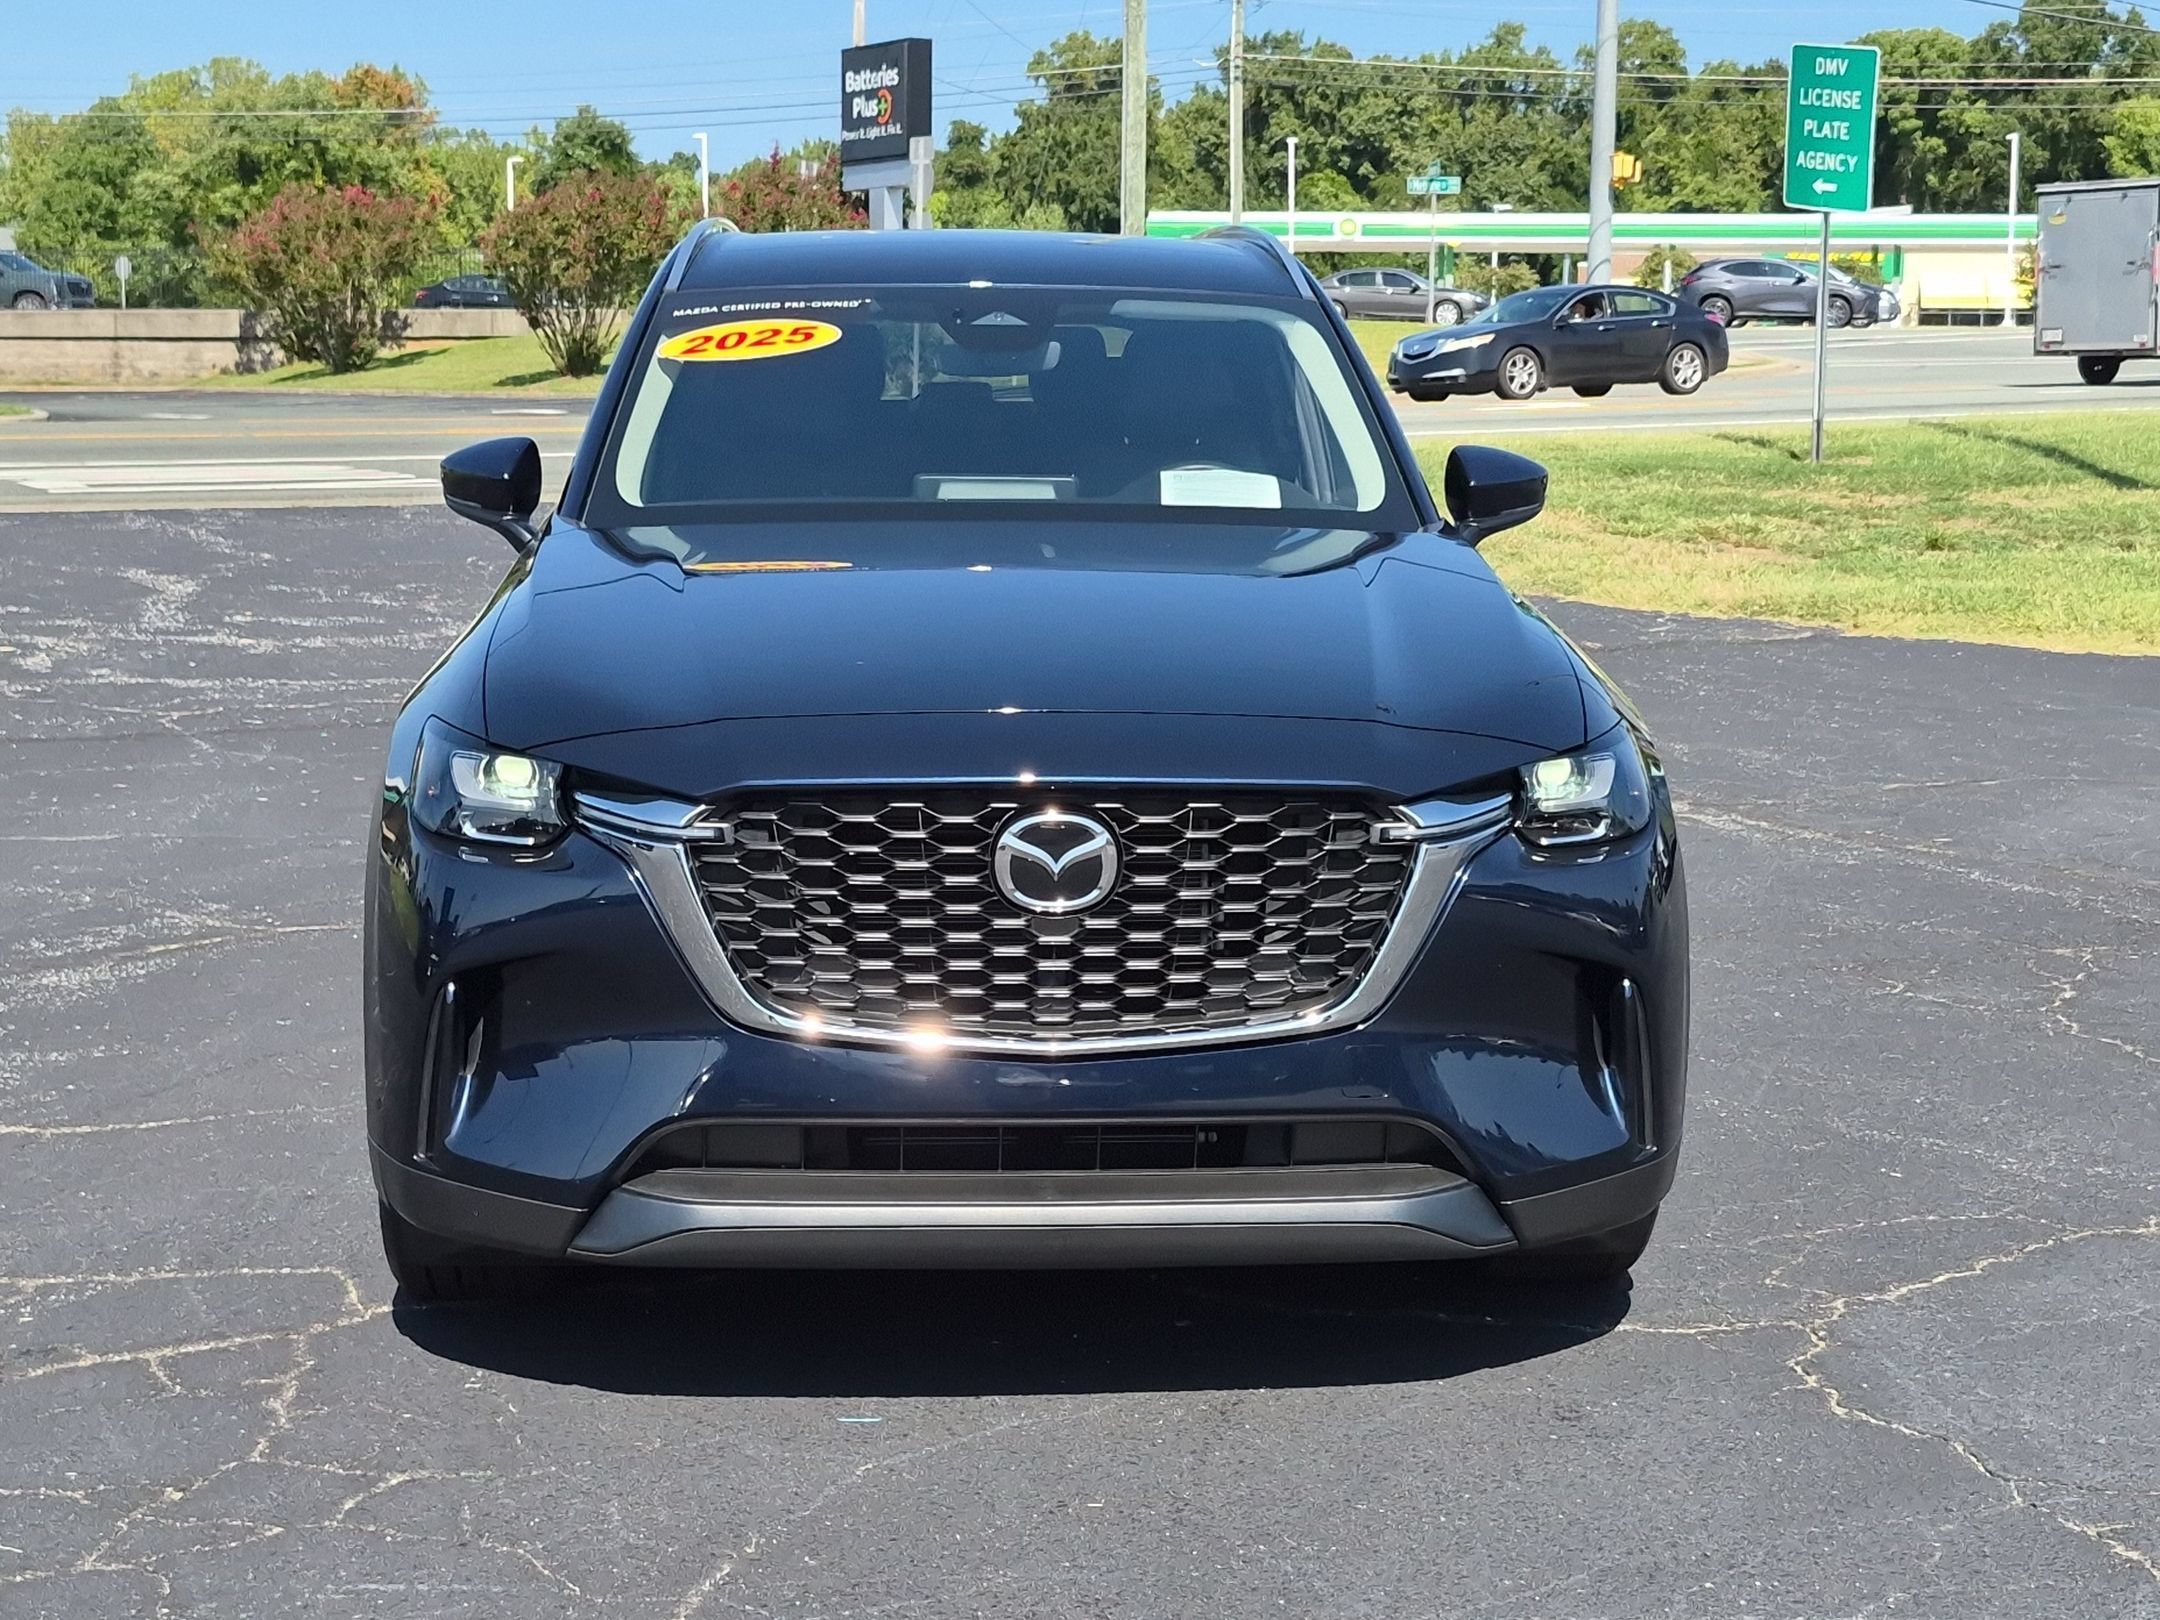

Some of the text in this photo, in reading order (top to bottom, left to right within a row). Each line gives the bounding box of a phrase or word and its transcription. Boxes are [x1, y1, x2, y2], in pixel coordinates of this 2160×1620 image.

[845, 63, 899, 93] Batteries
[1815, 57, 1849, 76] DMV
[852, 95, 878, 119] Plus
[1800, 87, 1861, 110] LICENSE
[1803, 118, 1849, 140] PLATE
[1796, 150, 1858, 173] AGENCY
[672, 305, 718, 317] MAZDA
[722, 302, 781, 312] CERTIFIED
[680, 326, 818, 355] 2025
